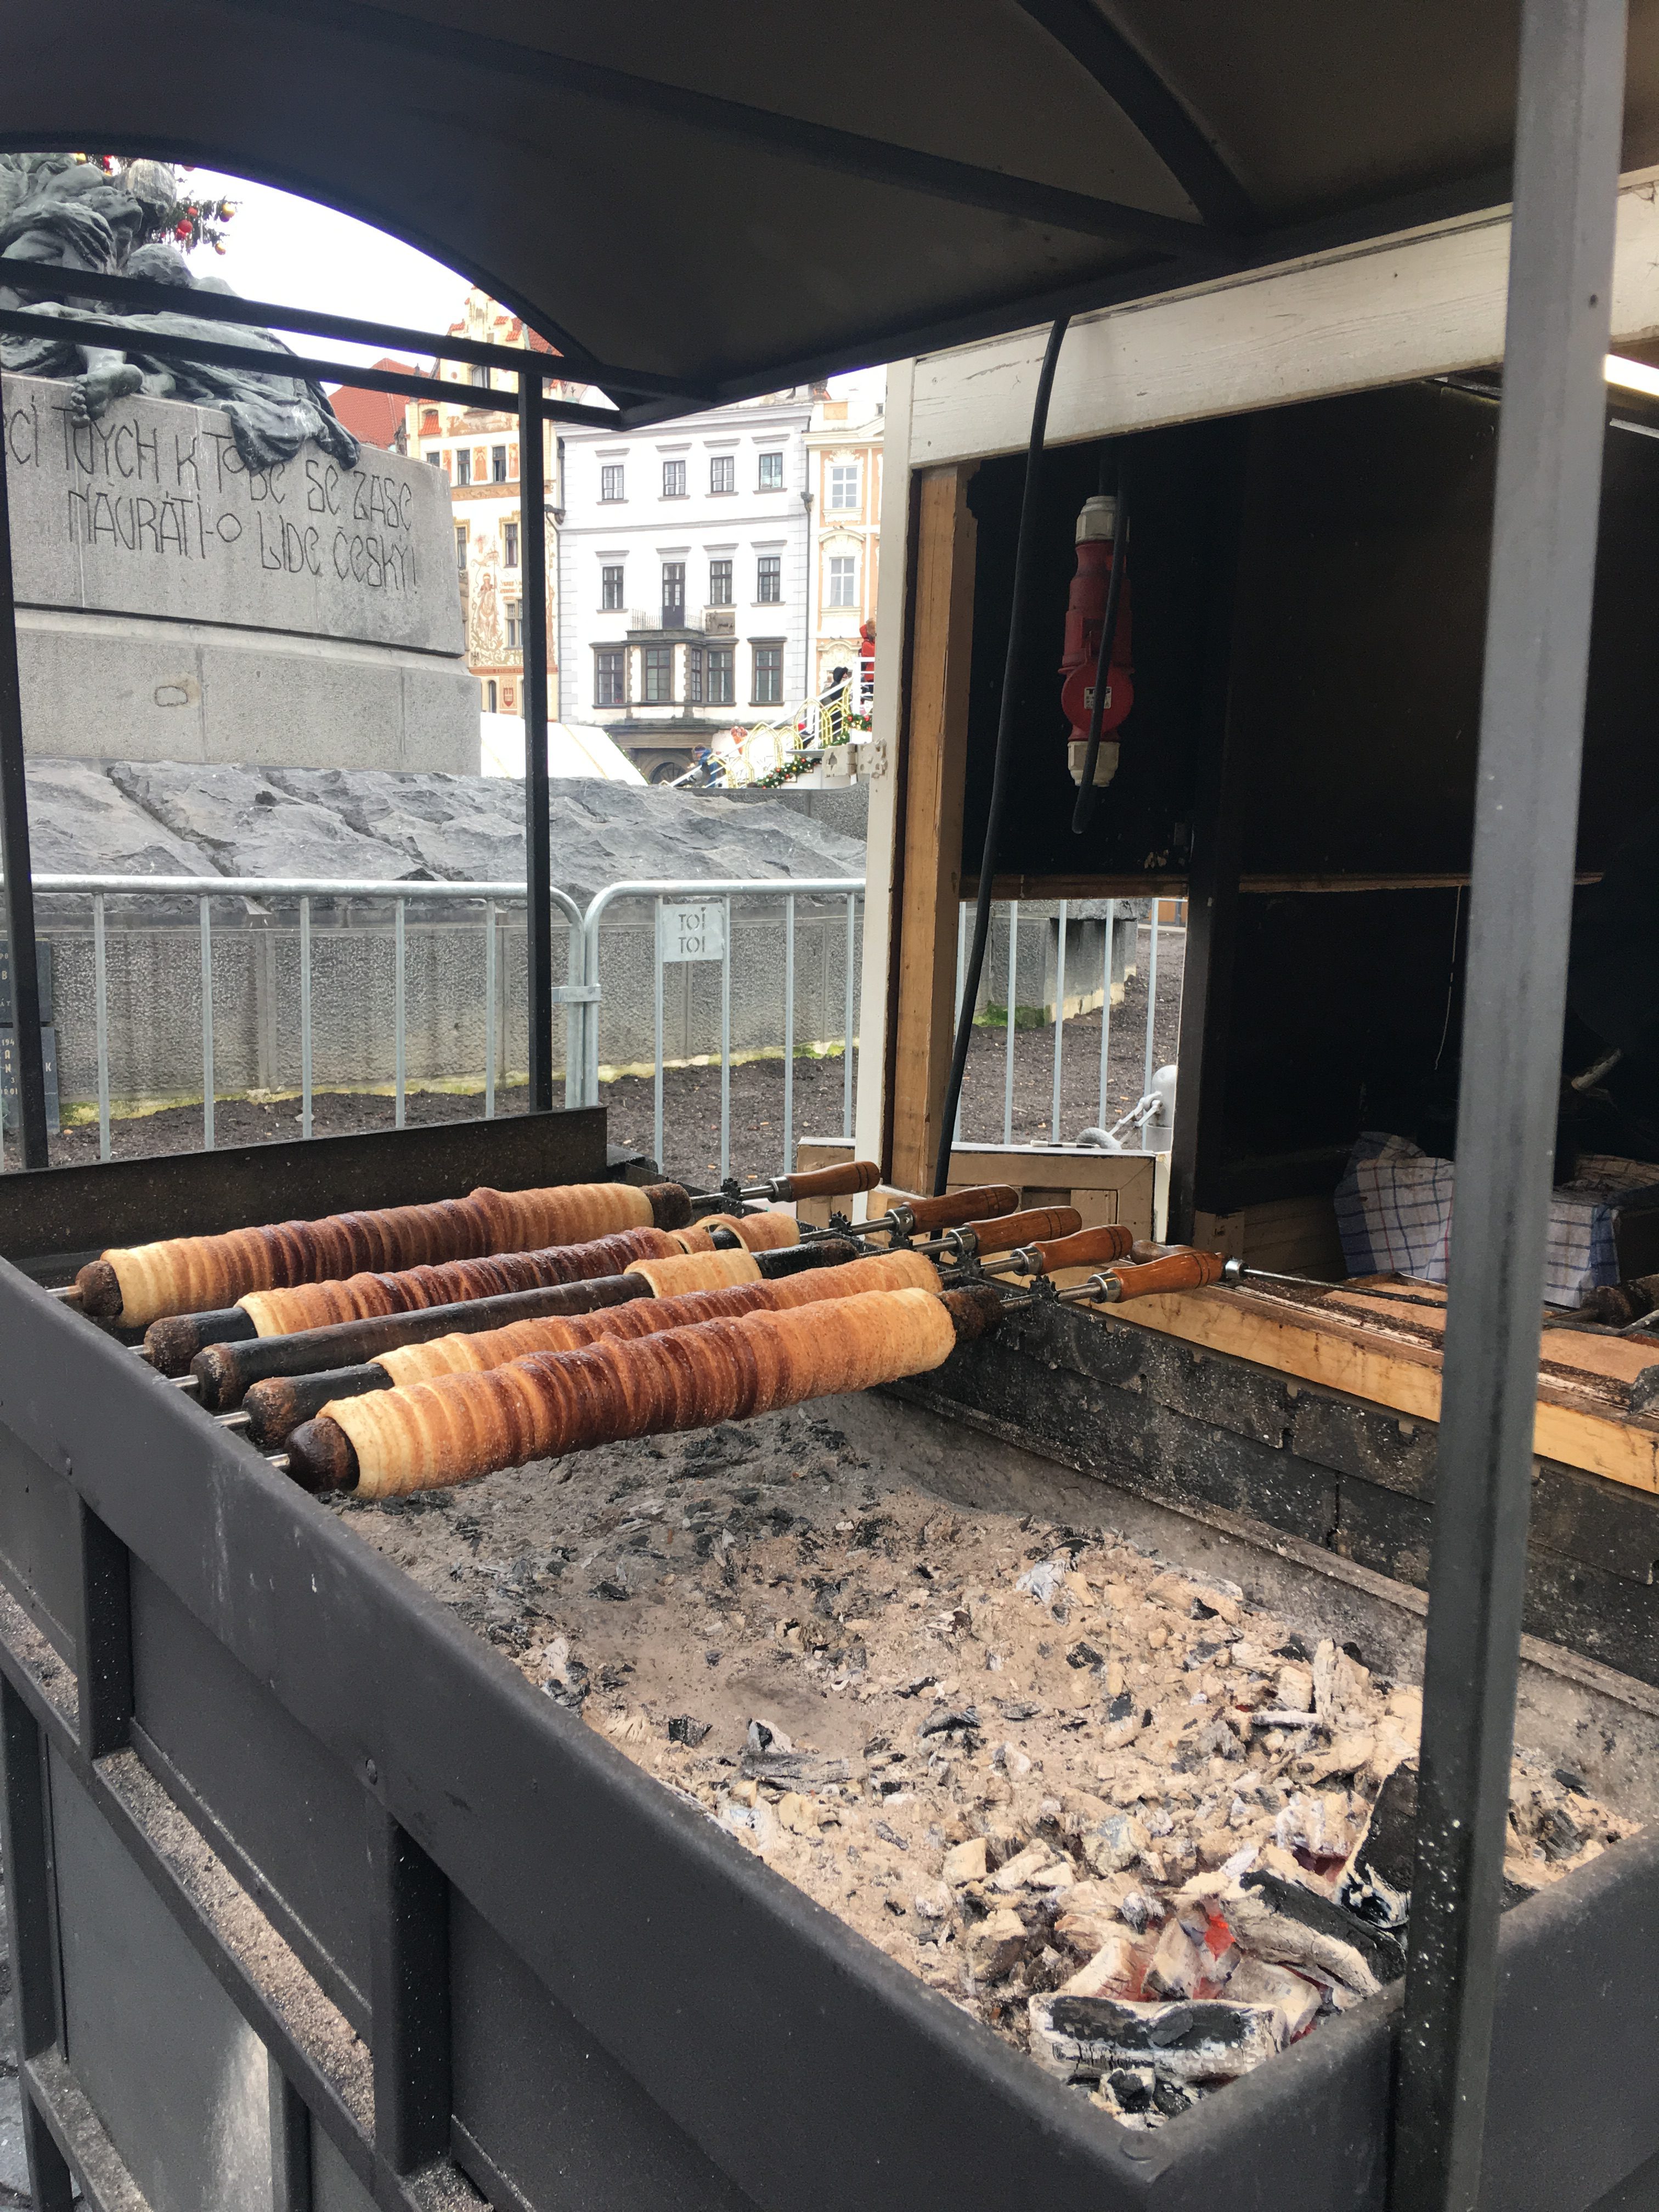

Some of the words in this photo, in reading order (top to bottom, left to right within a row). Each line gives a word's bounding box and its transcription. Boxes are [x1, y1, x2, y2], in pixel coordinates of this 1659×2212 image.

[175, 434, 201, 490] K
[305, 459, 341, 516] SE
[353, 470, 412, 531] ZASE
[678, 935, 706, 953] TOI
